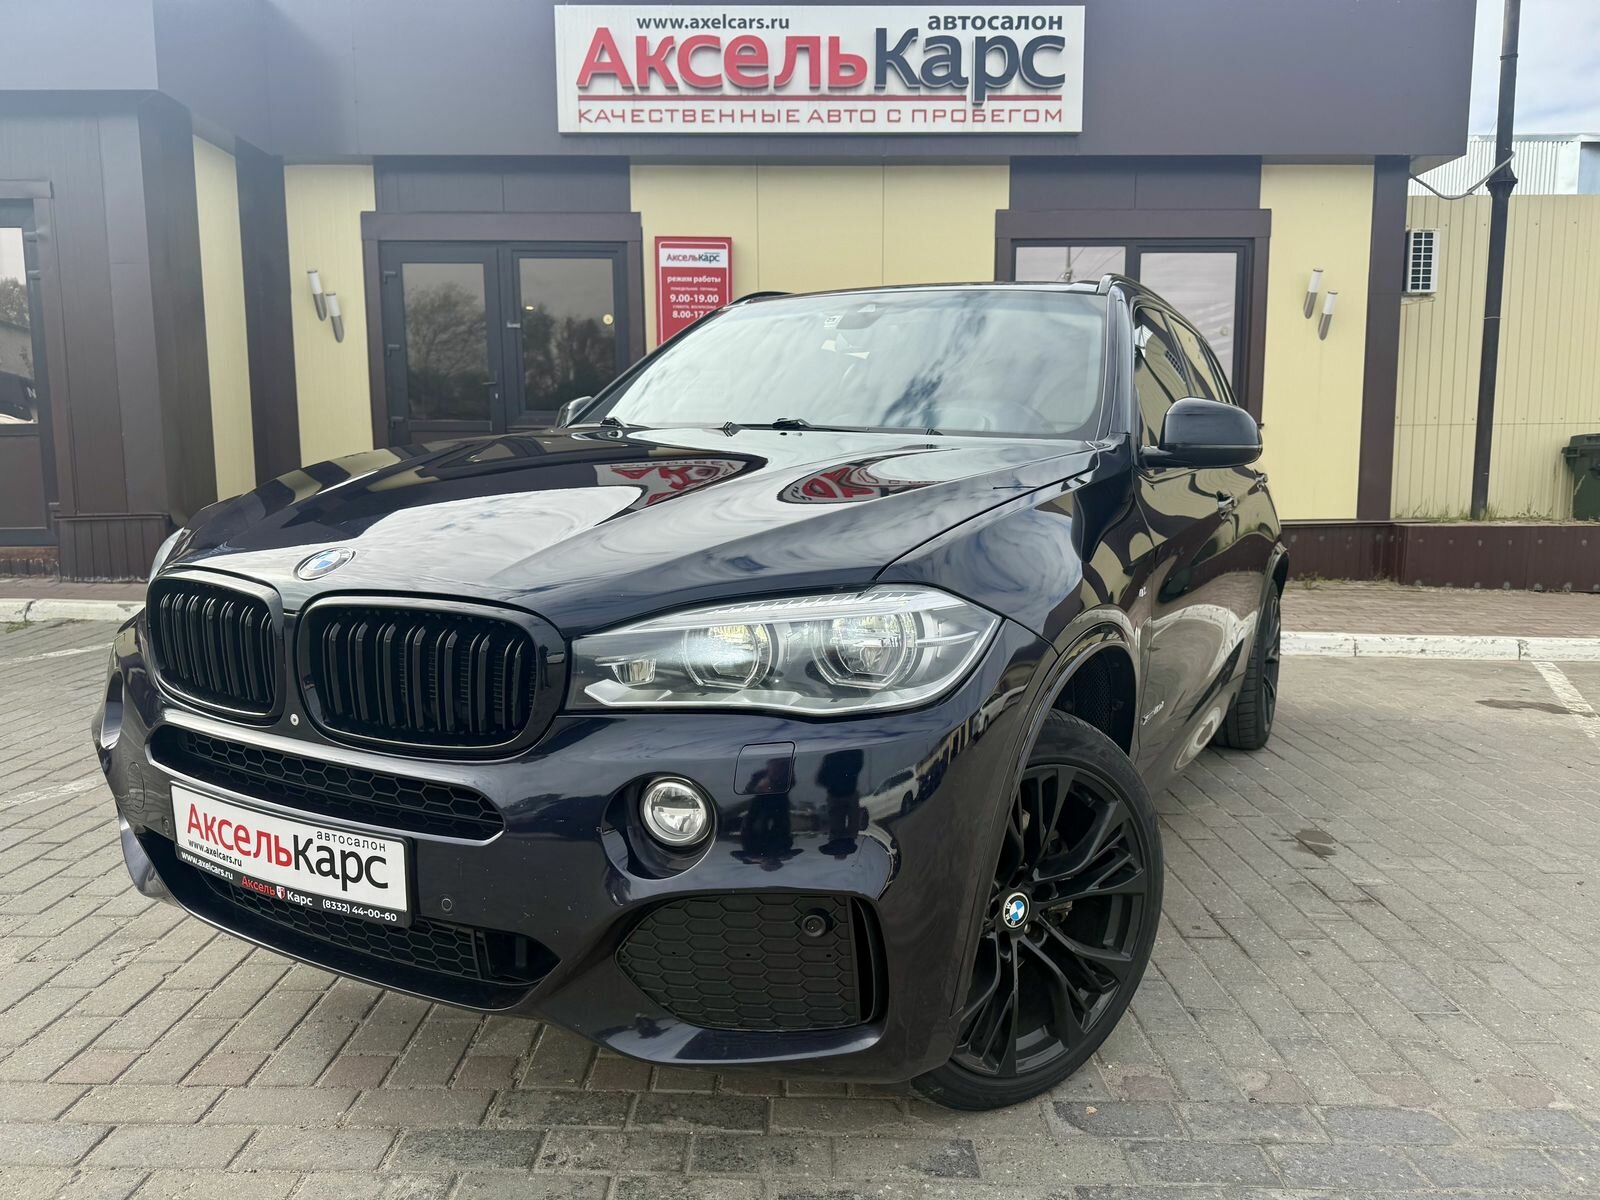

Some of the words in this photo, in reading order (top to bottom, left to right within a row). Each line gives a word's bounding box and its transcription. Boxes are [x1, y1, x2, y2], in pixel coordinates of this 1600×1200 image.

[636, 14, 790, 31] www.axelcars.ru
[927, 13, 1064, 31] автосалон
[578, 108, 800, 123] КАЧЕСТВЕННЫЕ
[807, 108, 877, 123] АВТО
[885, 108, 902, 123] С
[911, 108, 1063, 123] ПРОБЕГОМ
[667, 276, 692, 284] режим
[693, 275, 721, 284] работы
[669, 294, 719, 303] 9.00-19.00
[316, 830, 386, 853] автосалон
[188, 838, 243, 868] www.axelcars.ru
[180, 851, 234, 881] www.axelcars.ru
[241, 875, 276, 897] Аксель
[287, 890, 313, 907] Карс
[322, 898, 351, 914] (8332)
[351, 905, 397, 923] 44-00-60
